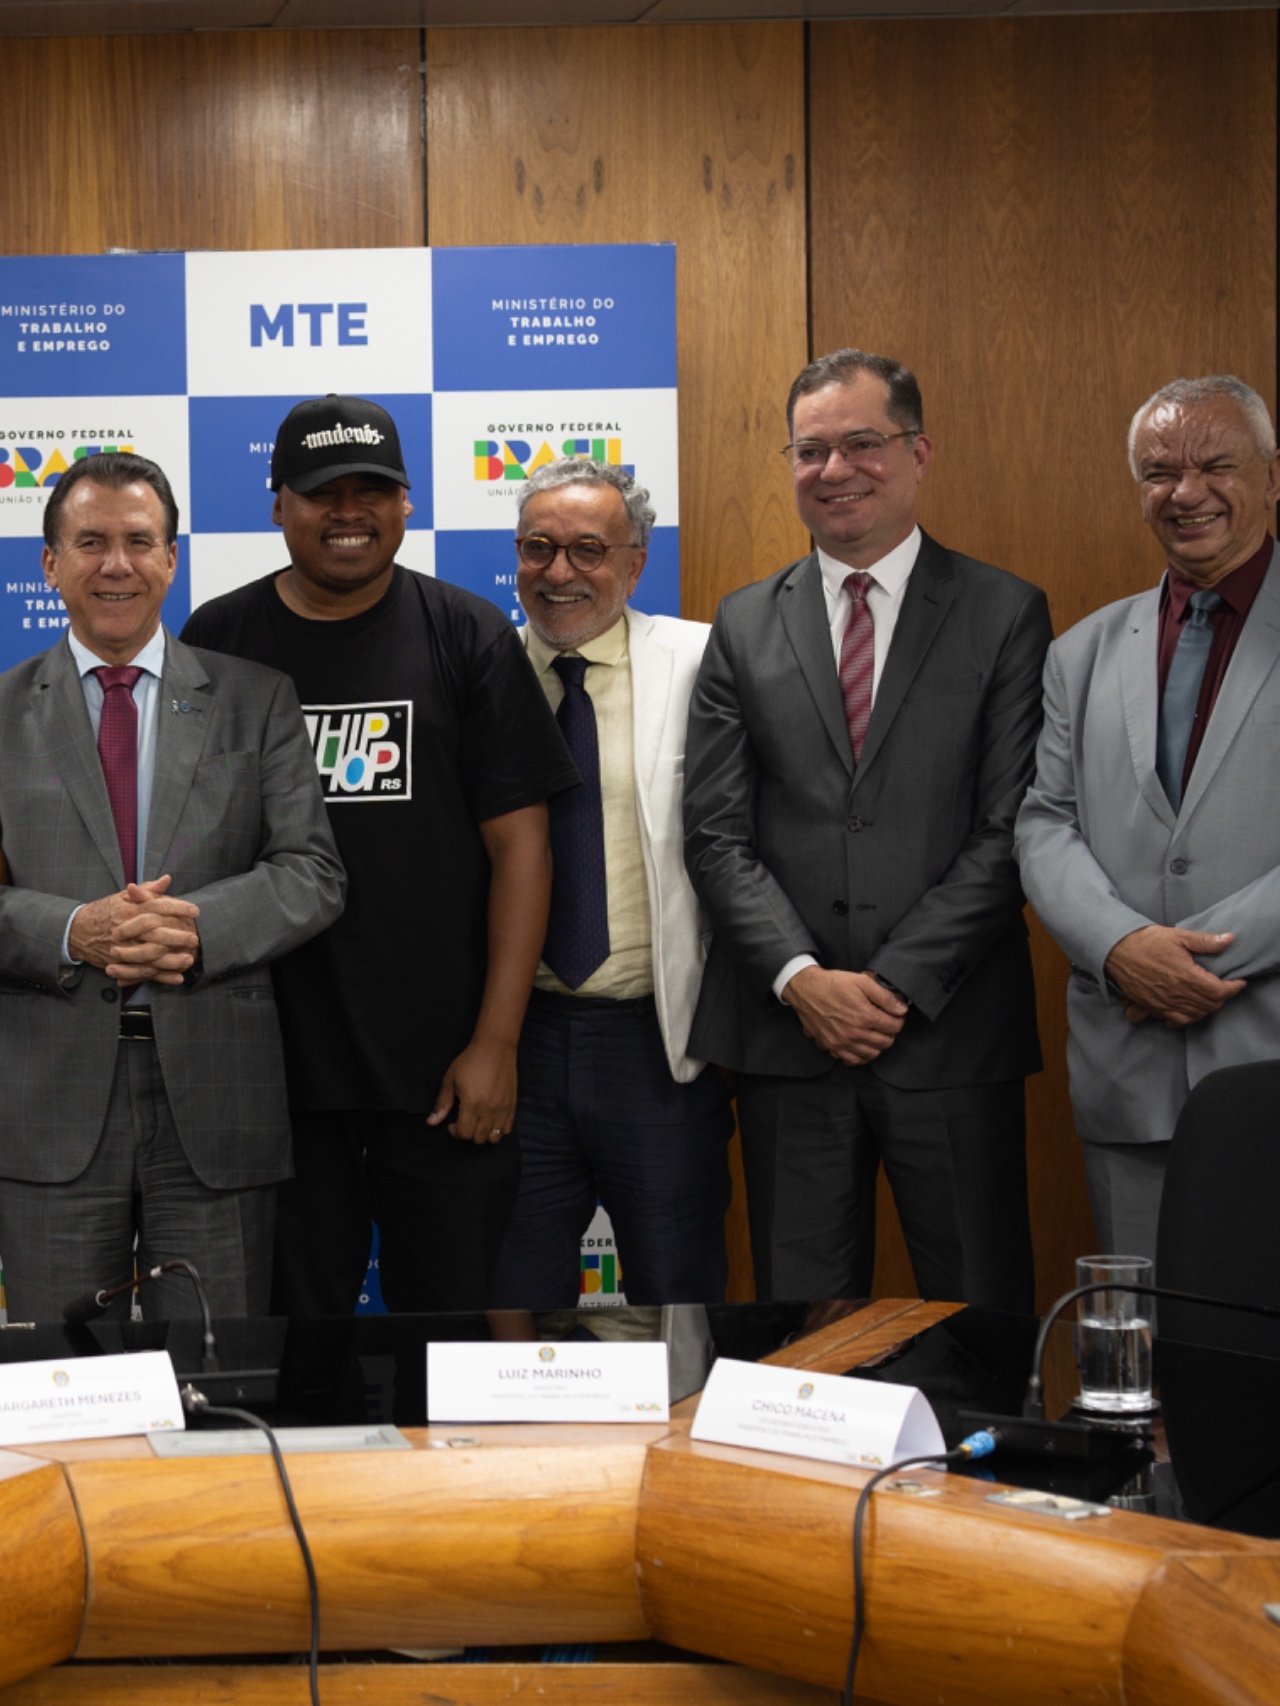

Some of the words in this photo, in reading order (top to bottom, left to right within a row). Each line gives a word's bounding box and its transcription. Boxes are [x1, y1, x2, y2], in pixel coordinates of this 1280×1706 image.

[1, 302, 96, 316] MINISTÉRIO
[103, 304, 125, 315] DO
[492, 296, 586, 310] MINISTÉRIO
[593, 297, 614, 309] DO
[249, 303, 369, 347] MTE
[510, 315, 596, 328] TRABALHO
[19, 322, 107, 334] TRABALHO
[17, 341, 26, 352] E
[33, 340, 110, 351] EMPREGO
[508, 335, 516, 346] E
[523, 334, 599, 345] EMPREGO
[487, 423, 554, 433] GOVERNO
[560, 422, 622, 432] FEDERAL
[72, 429, 134, 439] FEDERAL
[6, 582, 53, 594] MINIS
[24, 599, 67, 611] TRAB
[381, 778, 402, 790] RS
[498, 1368, 528, 1380] LUIZ
[532, 1368, 602, 1380] MARINHO
[77, 1390, 142, 1406] MENEZES
[752, 1399, 792, 1416] CHICO
[794, 1406, 847, 1424] MACENA
